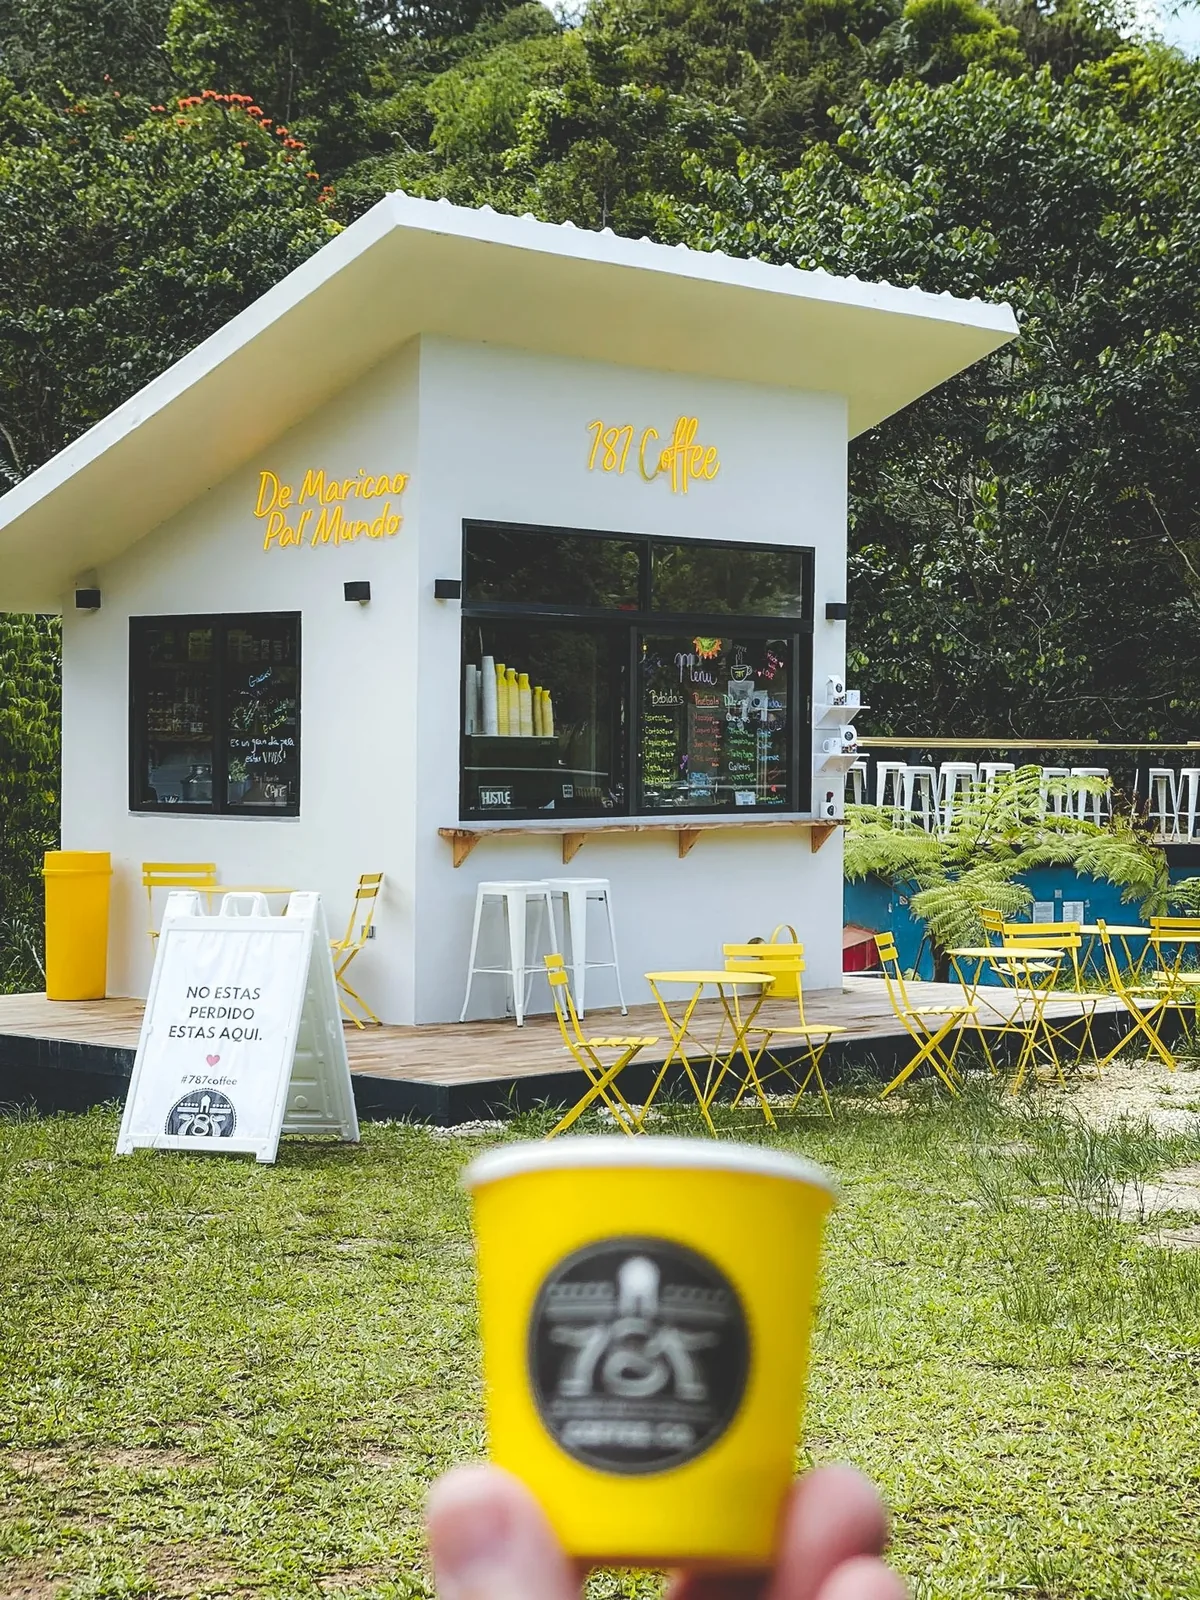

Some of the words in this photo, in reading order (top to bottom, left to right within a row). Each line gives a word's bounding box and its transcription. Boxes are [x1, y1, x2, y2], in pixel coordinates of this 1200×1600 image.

[588, 420, 634, 474] 787
[639, 415, 720, 494] Coffee
[253, 470, 292, 518] De
[298, 468, 409, 506] Maricao
[311, 502, 403, 547] Mundo
[674, 652, 717, 685] Menu
[186, 986, 211, 999] NO
[214, 986, 261, 1000] ESTAS
[188, 1006, 255, 1020] PERDIDO
[168, 1025, 216, 1039] ESTAS
[219, 1026, 263, 1042] AQUI.
[180, 1074, 238, 1086] #787coffee
